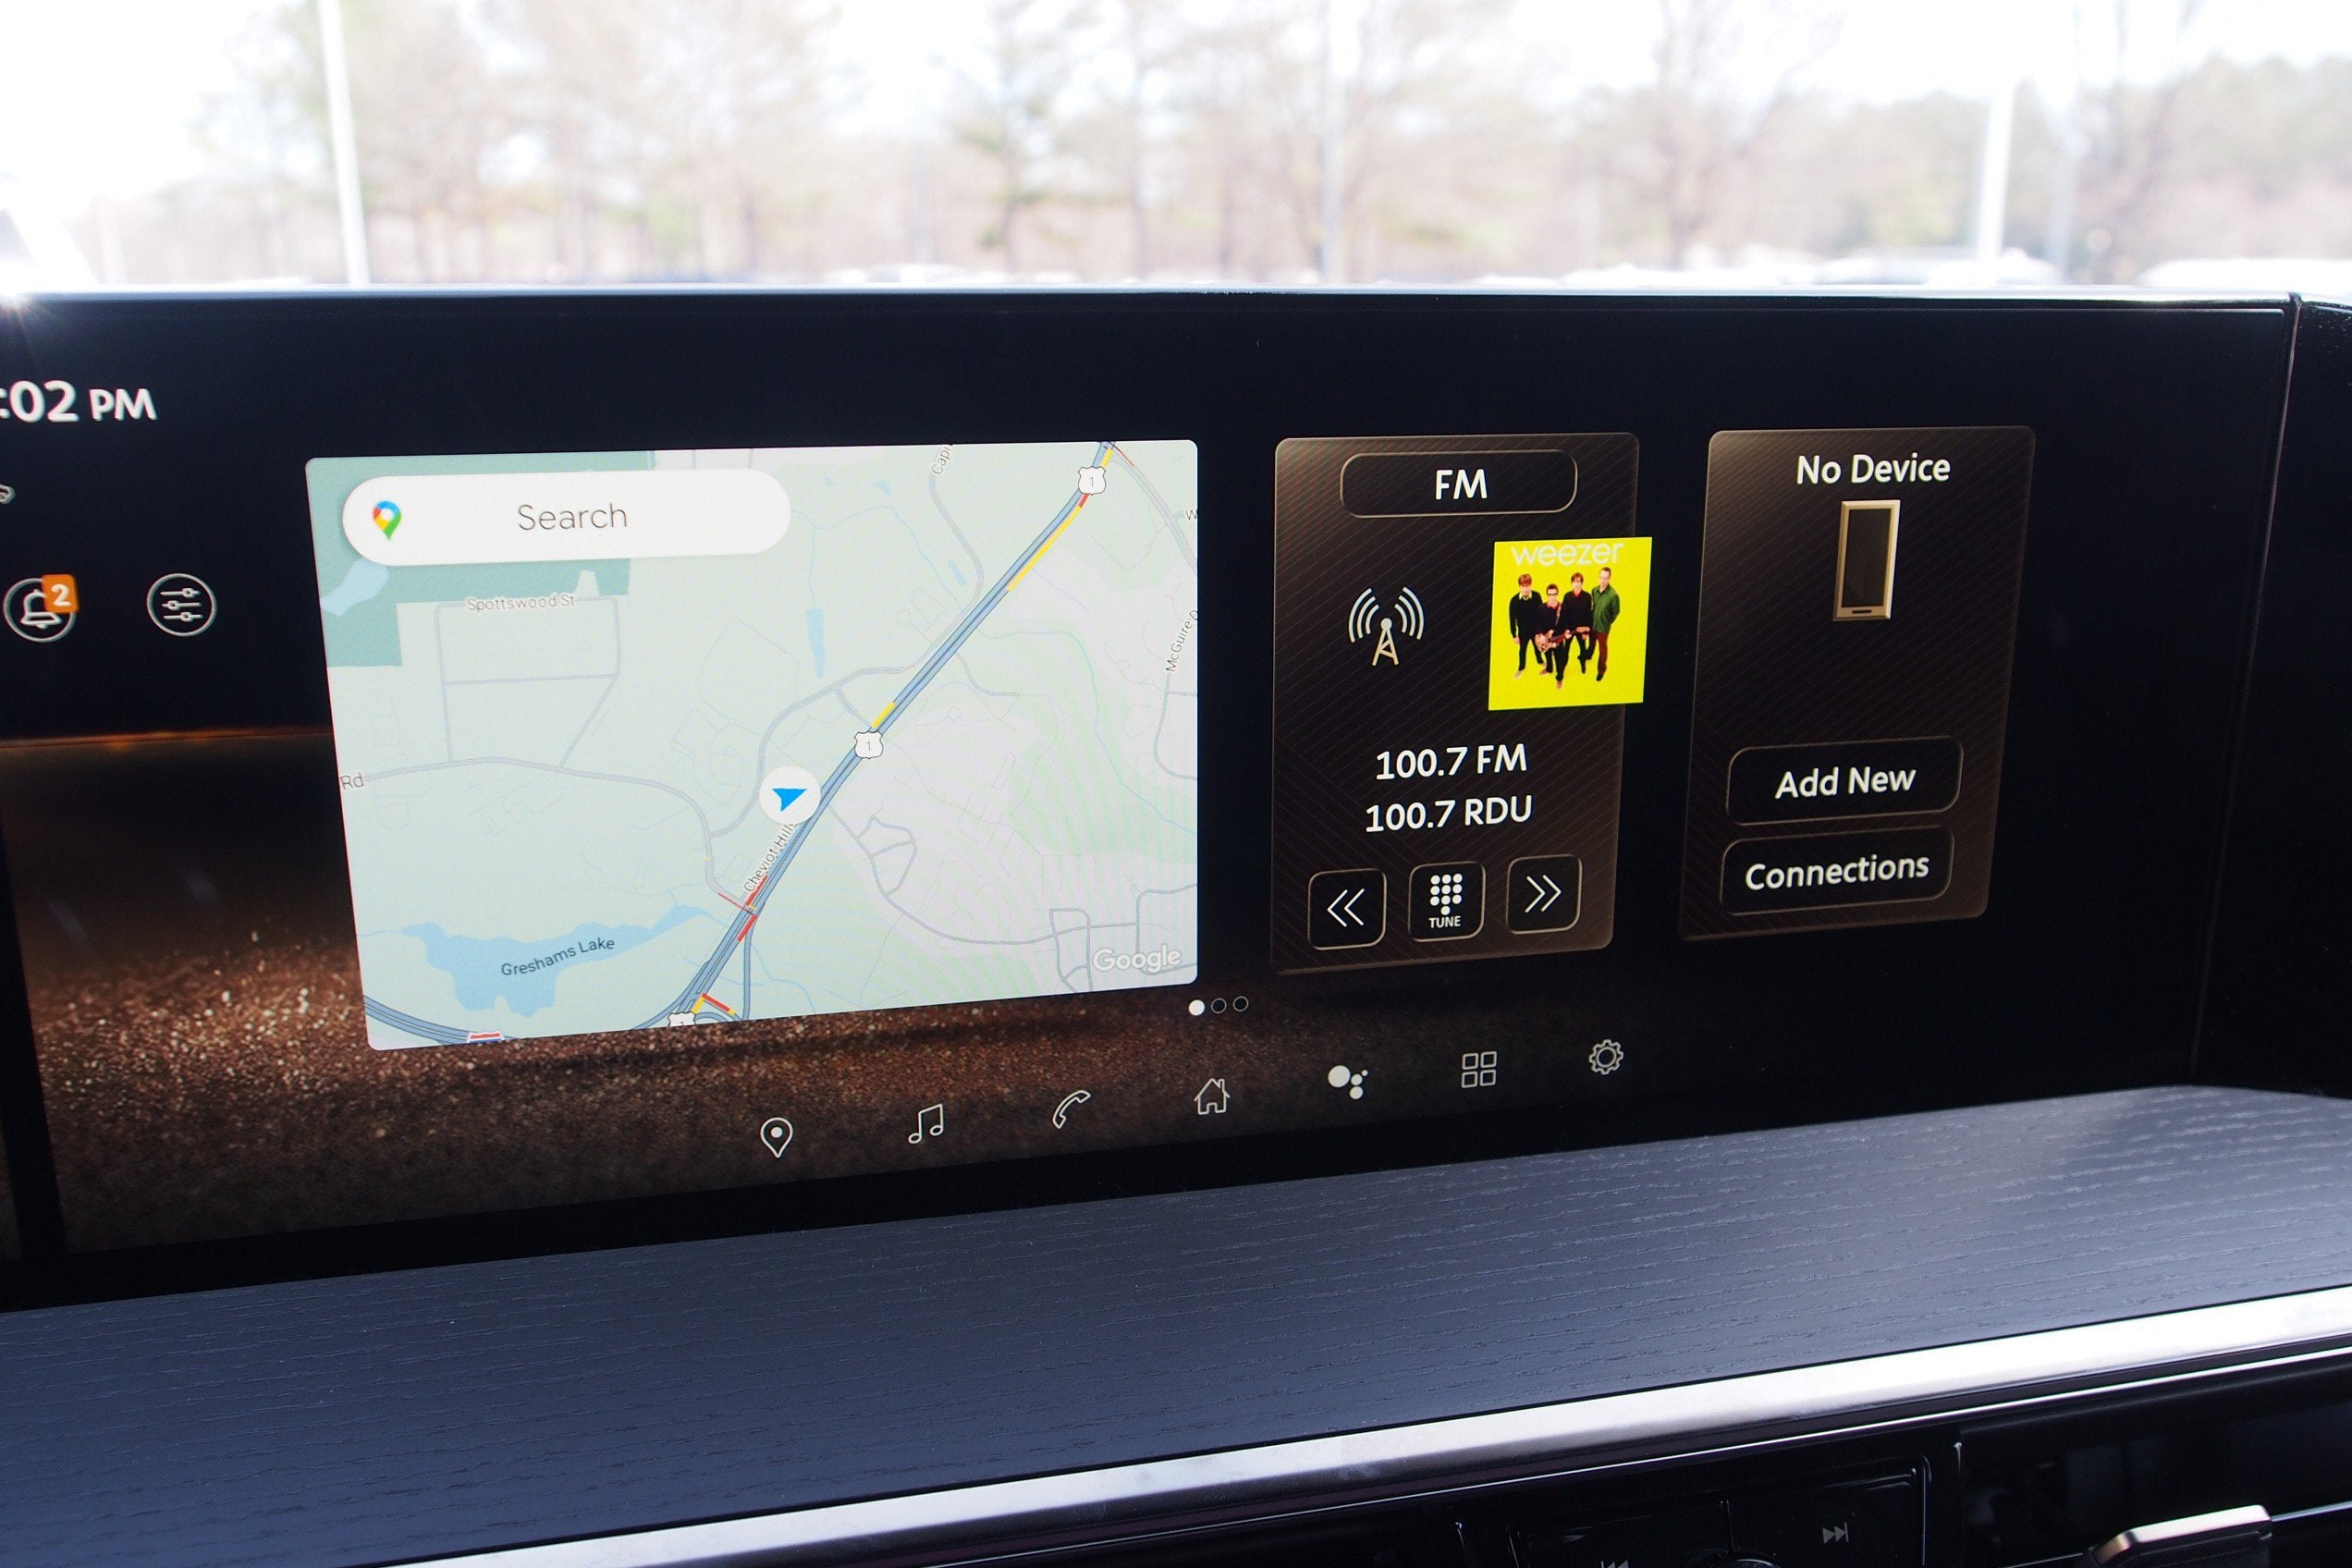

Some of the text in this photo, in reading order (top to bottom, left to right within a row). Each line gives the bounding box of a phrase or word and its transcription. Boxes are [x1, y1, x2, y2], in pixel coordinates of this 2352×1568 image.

[89, 388, 157, 422] PM
[1796, 452, 1951, 484] No Device
[1435, 469, 1488, 500] FM
[518, 502, 628, 531] Search
[1512, 542, 1624, 567] weezer
[51, 583, 71, 606] 2
[466, 594, 575, 613] Spottswood St
[1165, 620, 1194, 672] McGuire
[1376, 743, 1527, 780] 100.7 FM
[340, 772, 364, 790] Rd
[1774, 766, 1917, 799] Add New
[1366, 794, 1533, 833] 100.7 RDU
[1746, 853, 1929, 890] Connections
[1428, 915, 1462, 929] TUNE
[501, 937, 615, 975] Greshams Lake
[1092, 943, 1182, 974] Google
